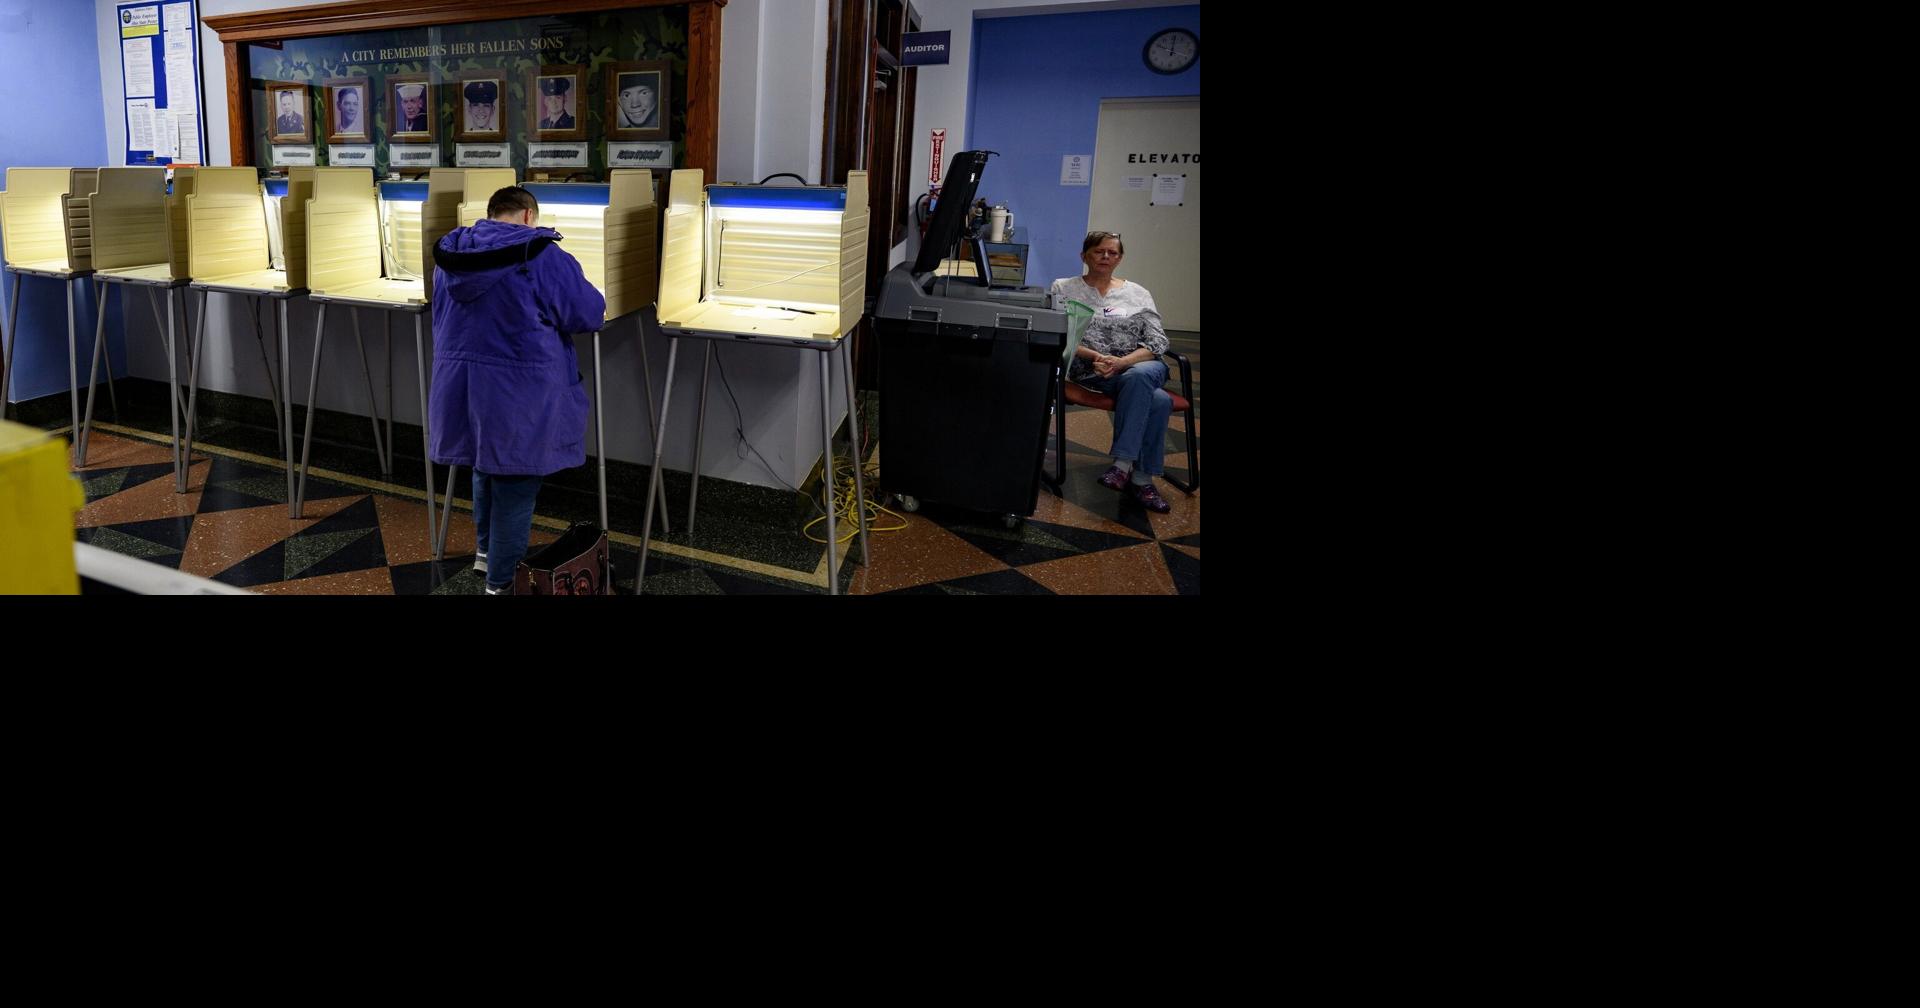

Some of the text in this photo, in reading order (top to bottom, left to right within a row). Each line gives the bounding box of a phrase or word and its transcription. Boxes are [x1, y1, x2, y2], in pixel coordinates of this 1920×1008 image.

[341, 35, 564, 63] A CITY REMEMBERS HER FALLEN SONS
[904, 44, 945, 53] AUDITOR
[1128, 153, 1200, 164] ELEVATO
